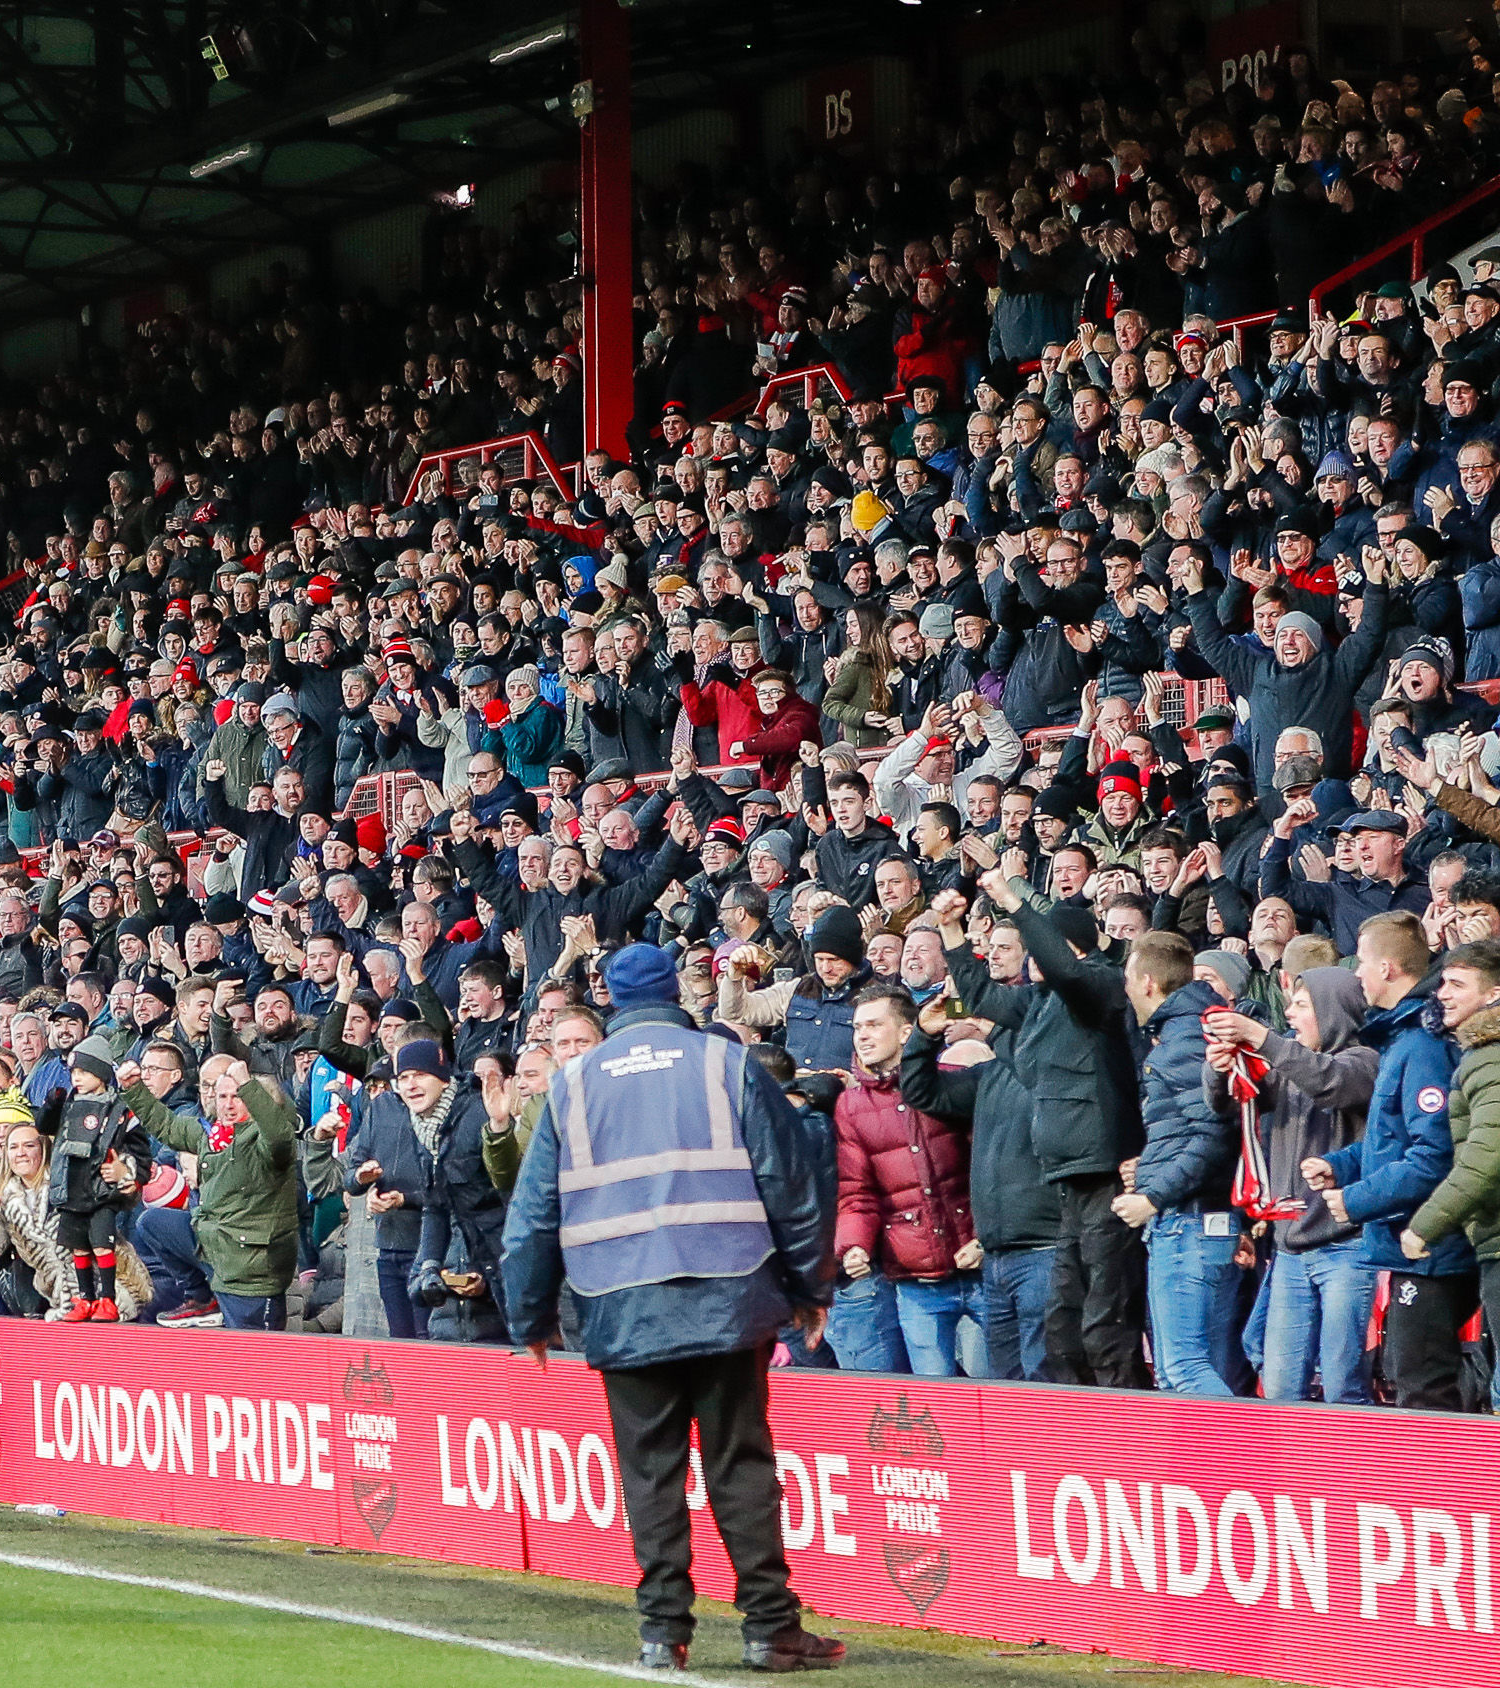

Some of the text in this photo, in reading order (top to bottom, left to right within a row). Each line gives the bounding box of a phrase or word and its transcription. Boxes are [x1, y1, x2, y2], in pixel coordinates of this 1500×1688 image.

[826, 90, 852, 139] DS
[33, 1379, 336, 1491] LONDON PRIDE
[344, 1411, 399, 1443] LONDON
[353, 1441, 393, 1473] PRIDE
[436, 1414, 631, 1532] LONDO
[871, 1464, 950, 1501] LONDON
[885, 1499, 942, 1537] PRIDE
[1010, 1469, 1330, 1615] LONDON
